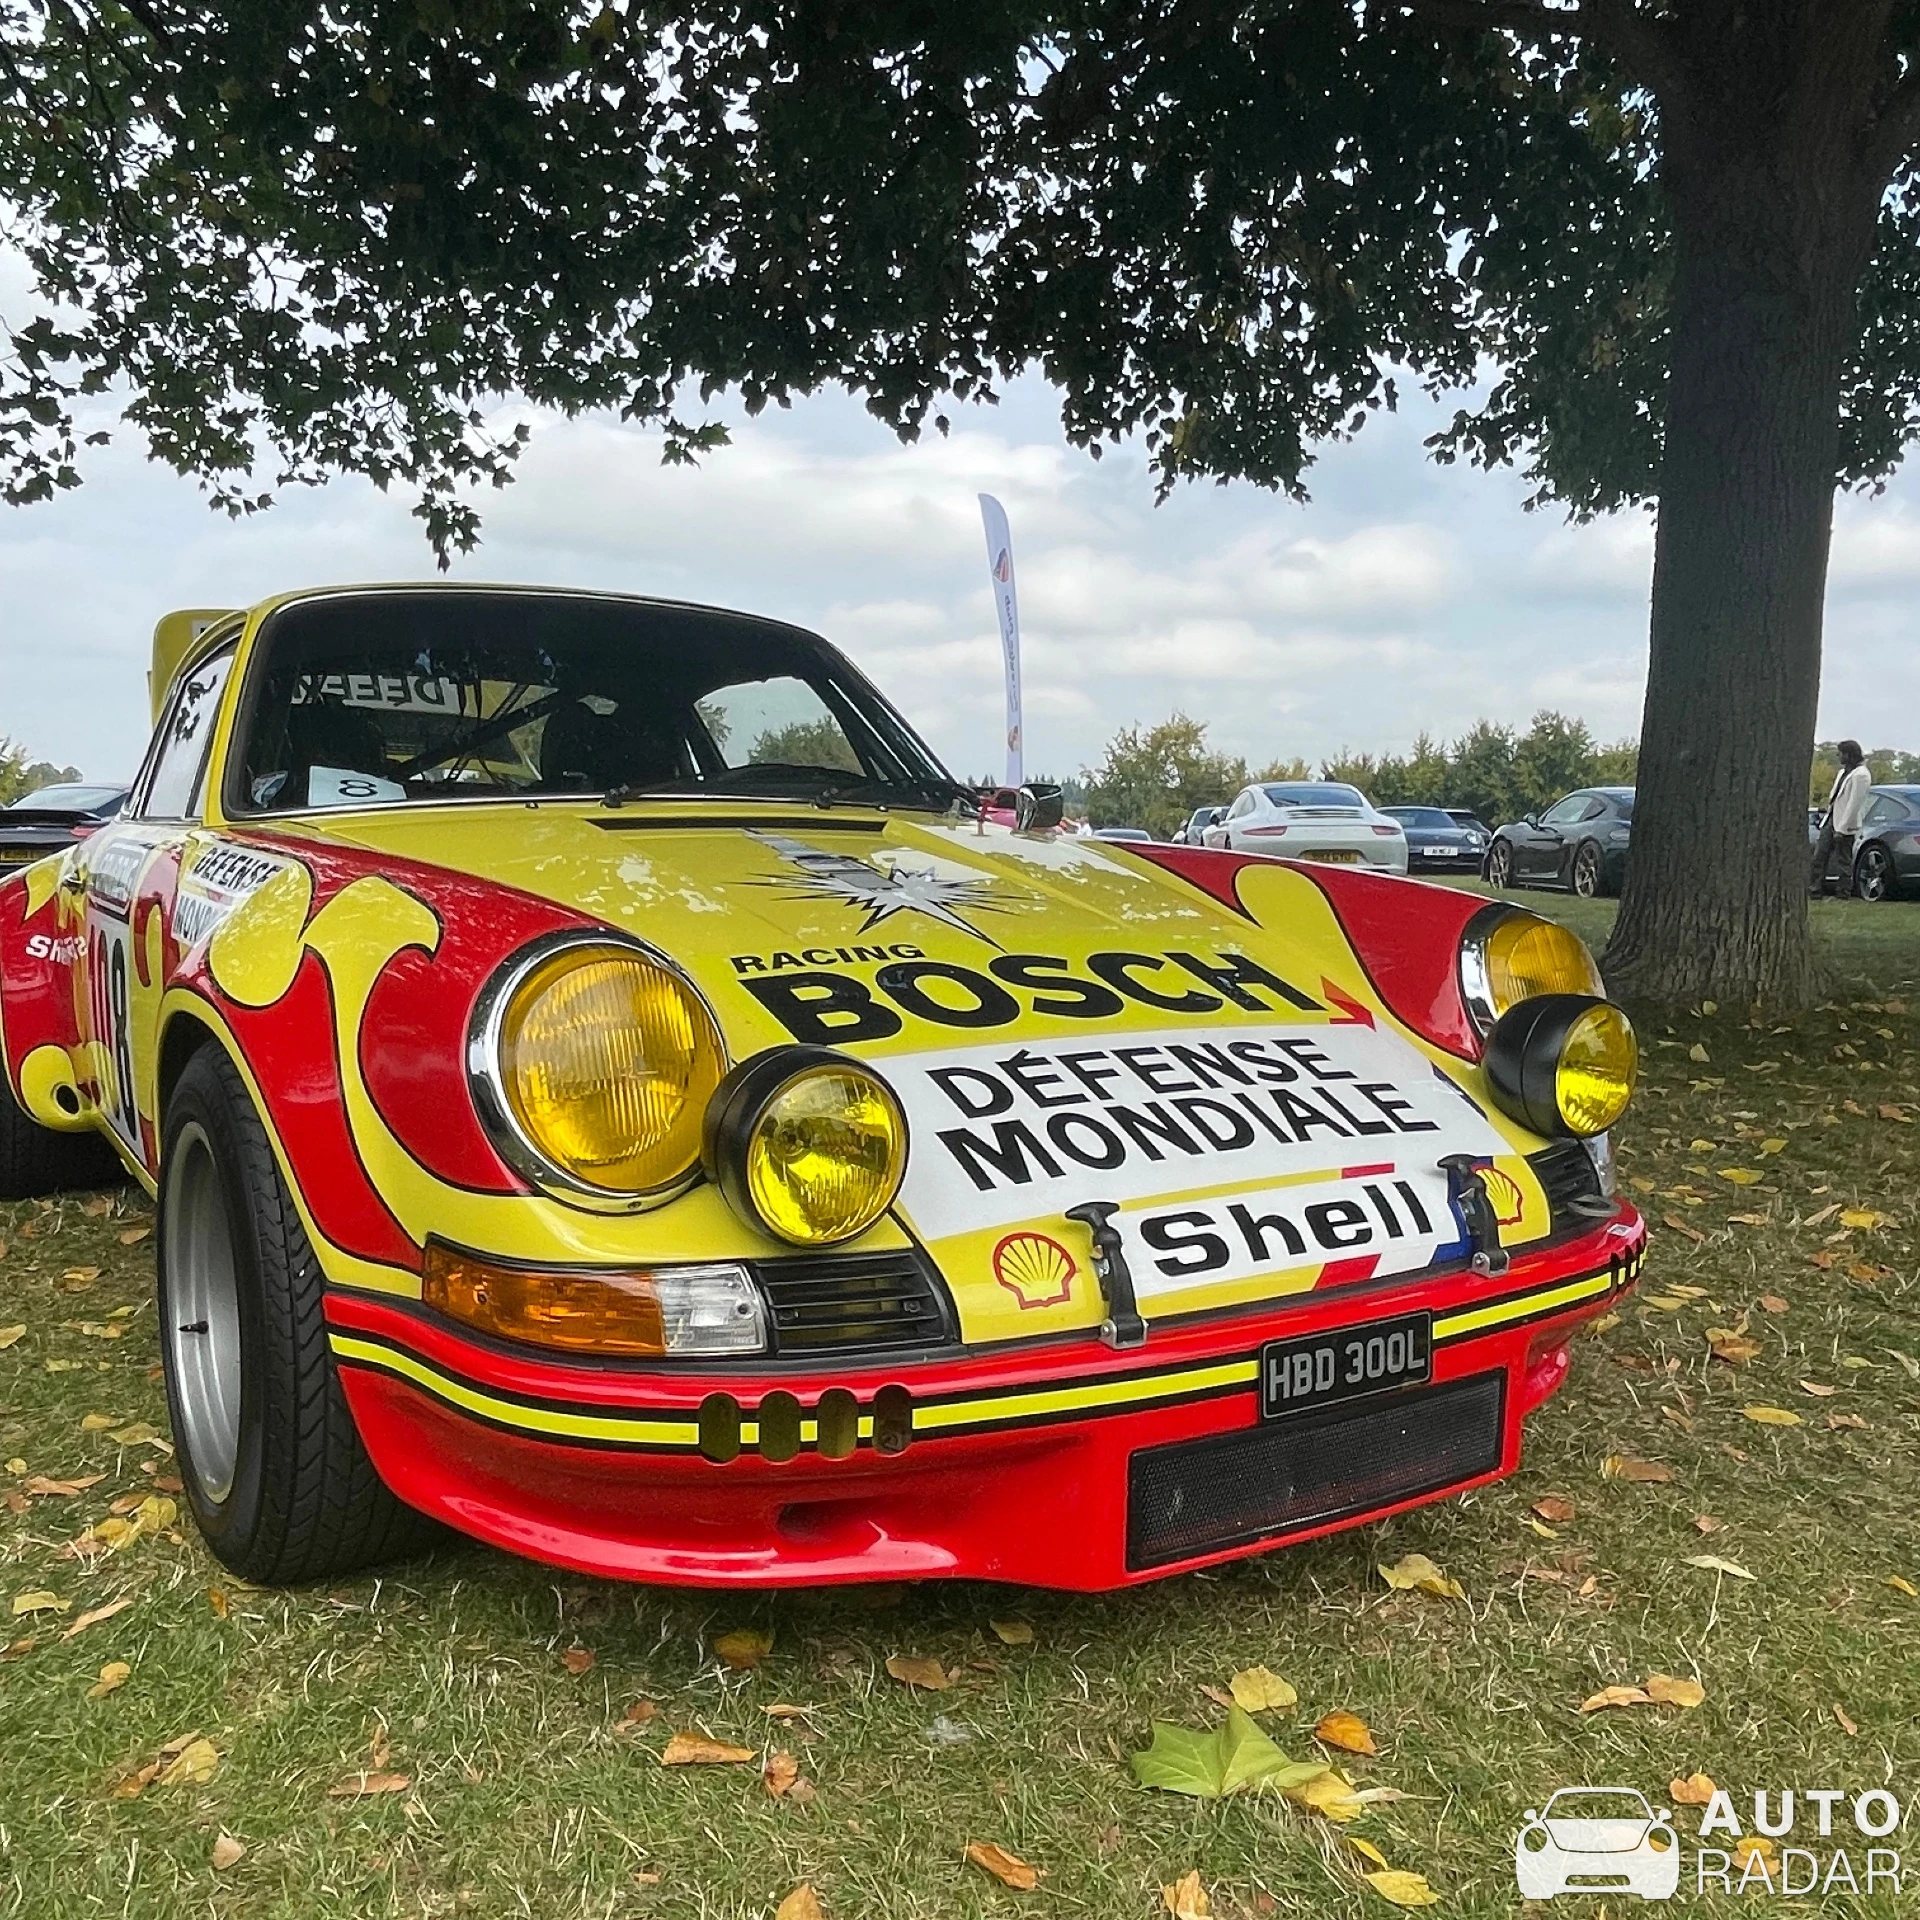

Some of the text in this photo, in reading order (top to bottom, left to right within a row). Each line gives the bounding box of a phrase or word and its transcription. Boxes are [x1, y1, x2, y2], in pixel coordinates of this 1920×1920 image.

[730, 943, 926, 974] RACING
[738, 950, 1326, 1046] BOSCH
[926, 1039, 1357, 1118] DÉFENSE
[937, 1084, 1439, 1192] MONDIALE
[1139, 1181, 1432, 1278] Shell
[1269, 1329, 1426, 1402] HBD 300L
